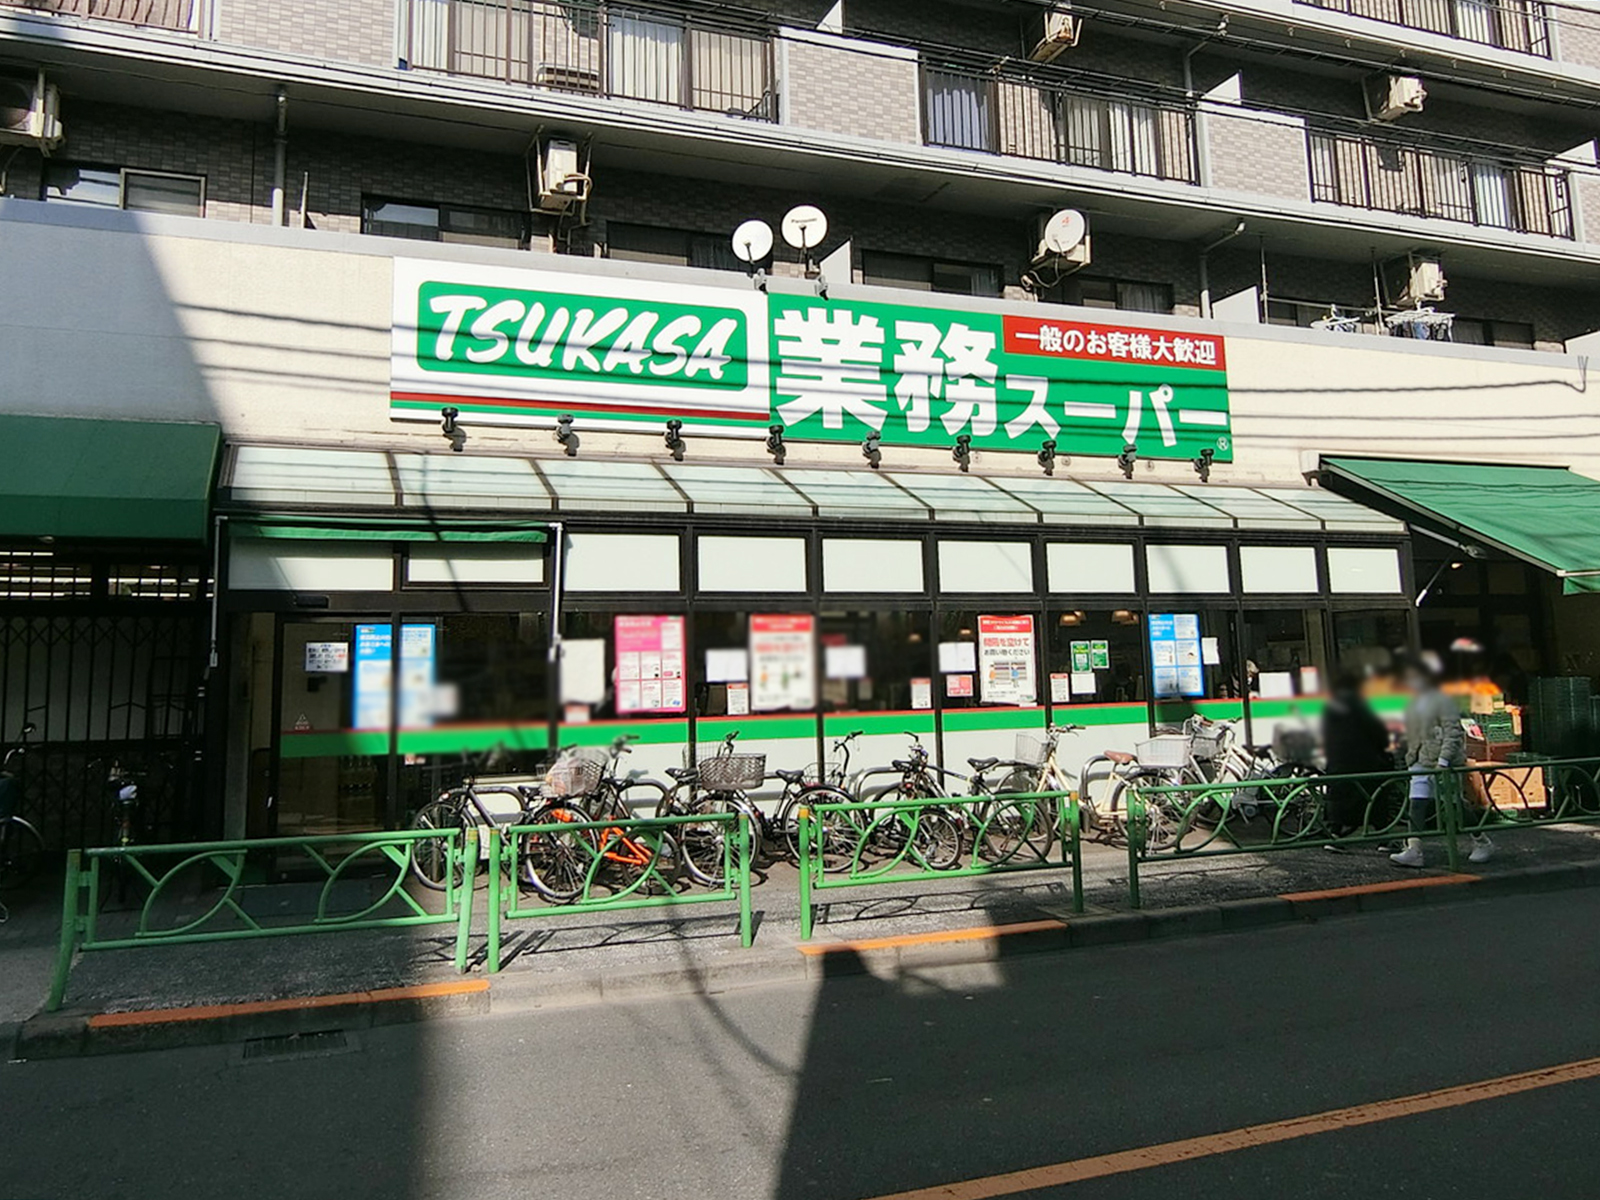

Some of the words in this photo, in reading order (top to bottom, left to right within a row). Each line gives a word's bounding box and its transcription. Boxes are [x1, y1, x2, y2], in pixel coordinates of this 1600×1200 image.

[429, 294, 738, 380] TSUKASA
[774, 307, 1228, 448] 業務スーパー
[1015, 325, 1216, 365] 一般のお客様大歓迎
